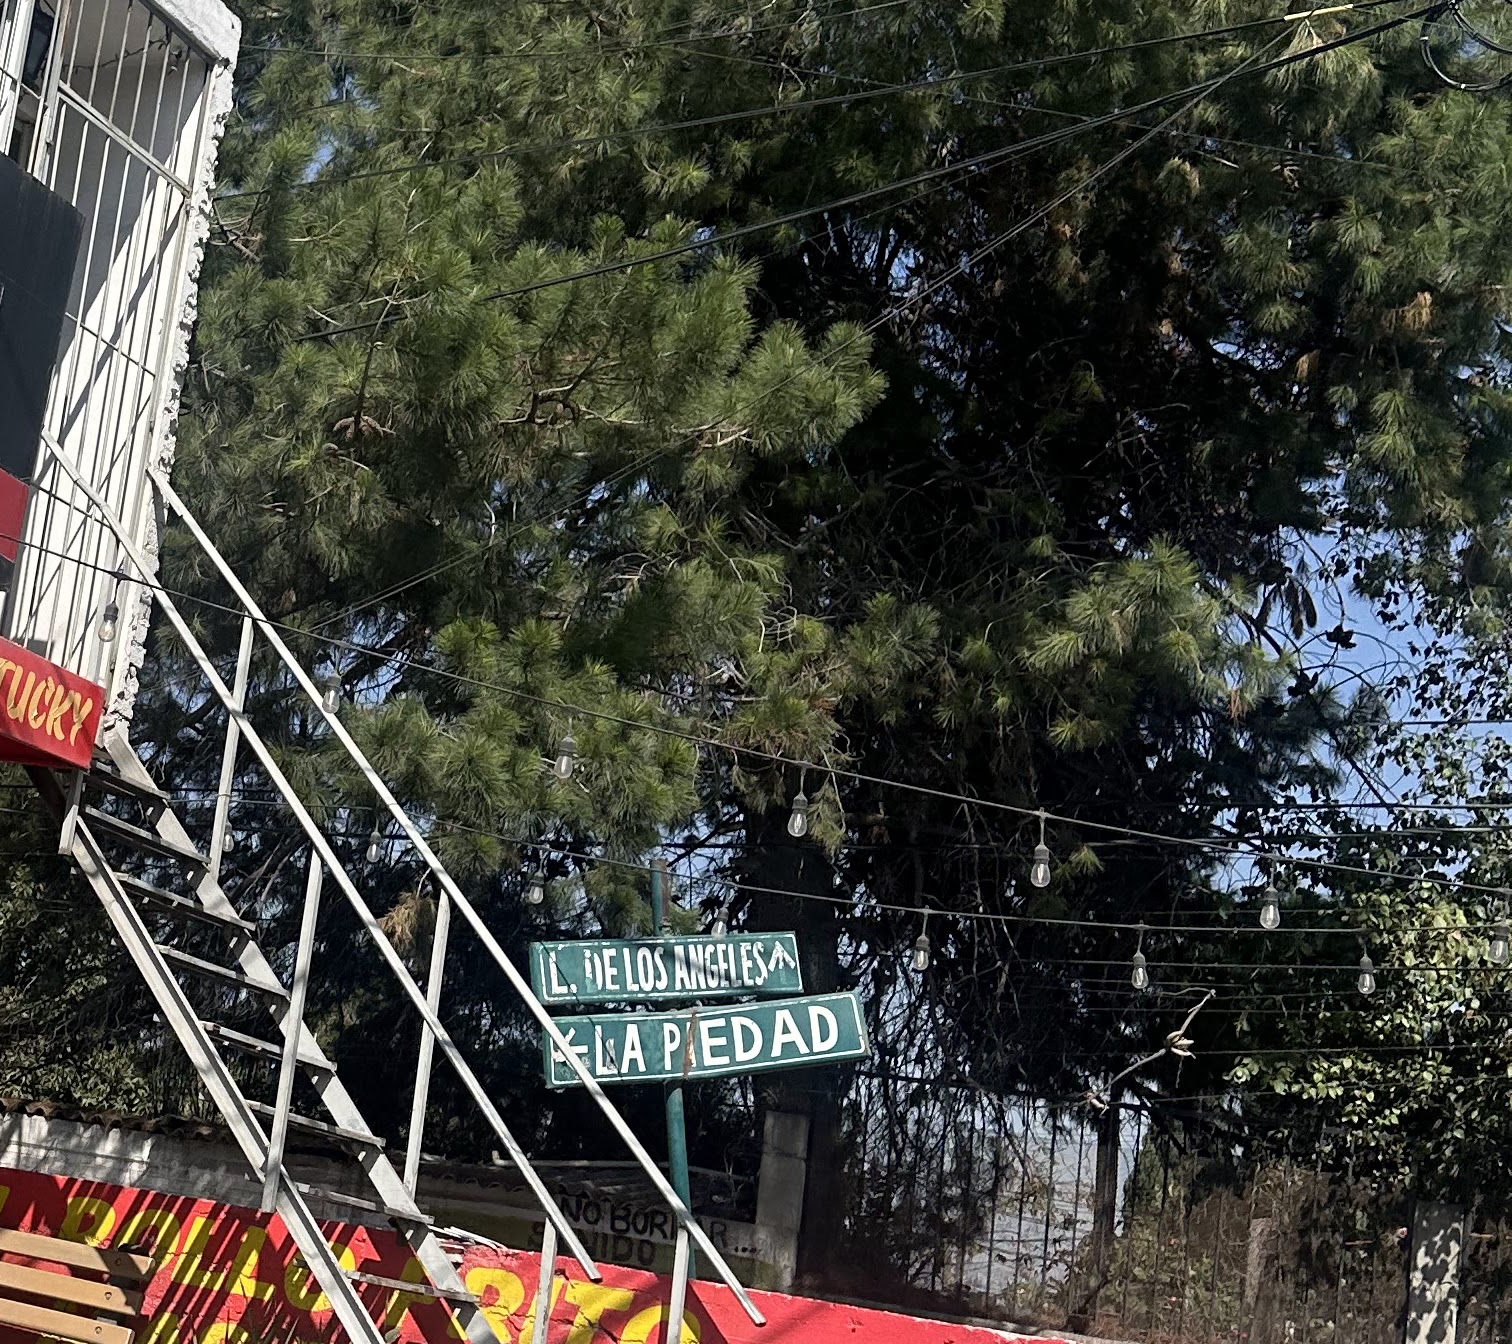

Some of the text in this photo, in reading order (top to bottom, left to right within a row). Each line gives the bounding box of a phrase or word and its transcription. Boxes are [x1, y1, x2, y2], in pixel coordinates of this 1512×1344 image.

[584, 948, 620, 991] DE
[622, 946, 668, 992] LOS
[673, 940, 769, 991] ANGELES
[594, 1023, 647, 1076] LA
[561, 1196, 602, 1225] NO
